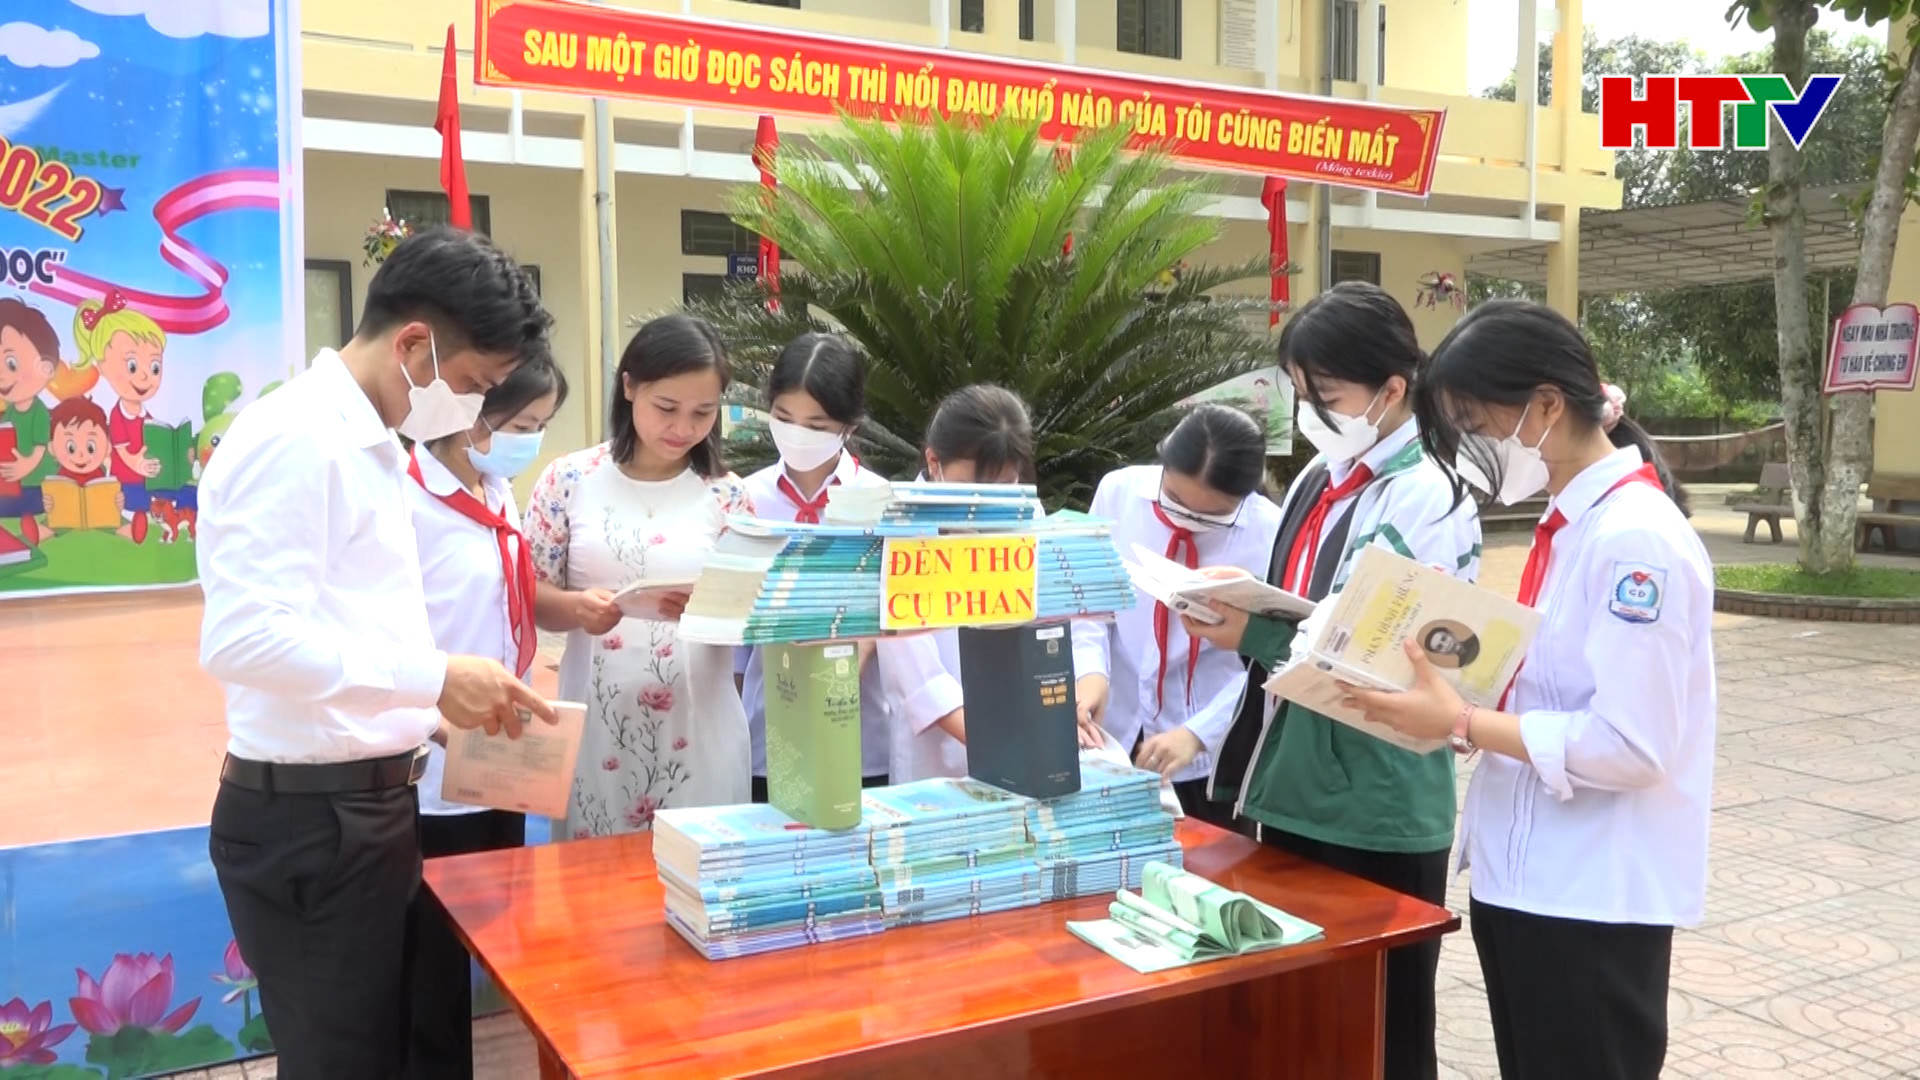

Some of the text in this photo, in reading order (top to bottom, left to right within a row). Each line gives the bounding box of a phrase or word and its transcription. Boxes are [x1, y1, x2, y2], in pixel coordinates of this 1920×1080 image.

[523, 28, 1399, 167] SAU MỘT GIỜ ĐỌC SÁCH THÌ NỔI ĐAU KHỔ NÀO CỦA TÔI CŨNG BIẾN MẤT
[37, 146, 141, 168] Master
[0, 137, 98, 241] 022
[964, 538, 1036, 572] THỜ
[888, 588, 1033, 626] CỤ PHAN
